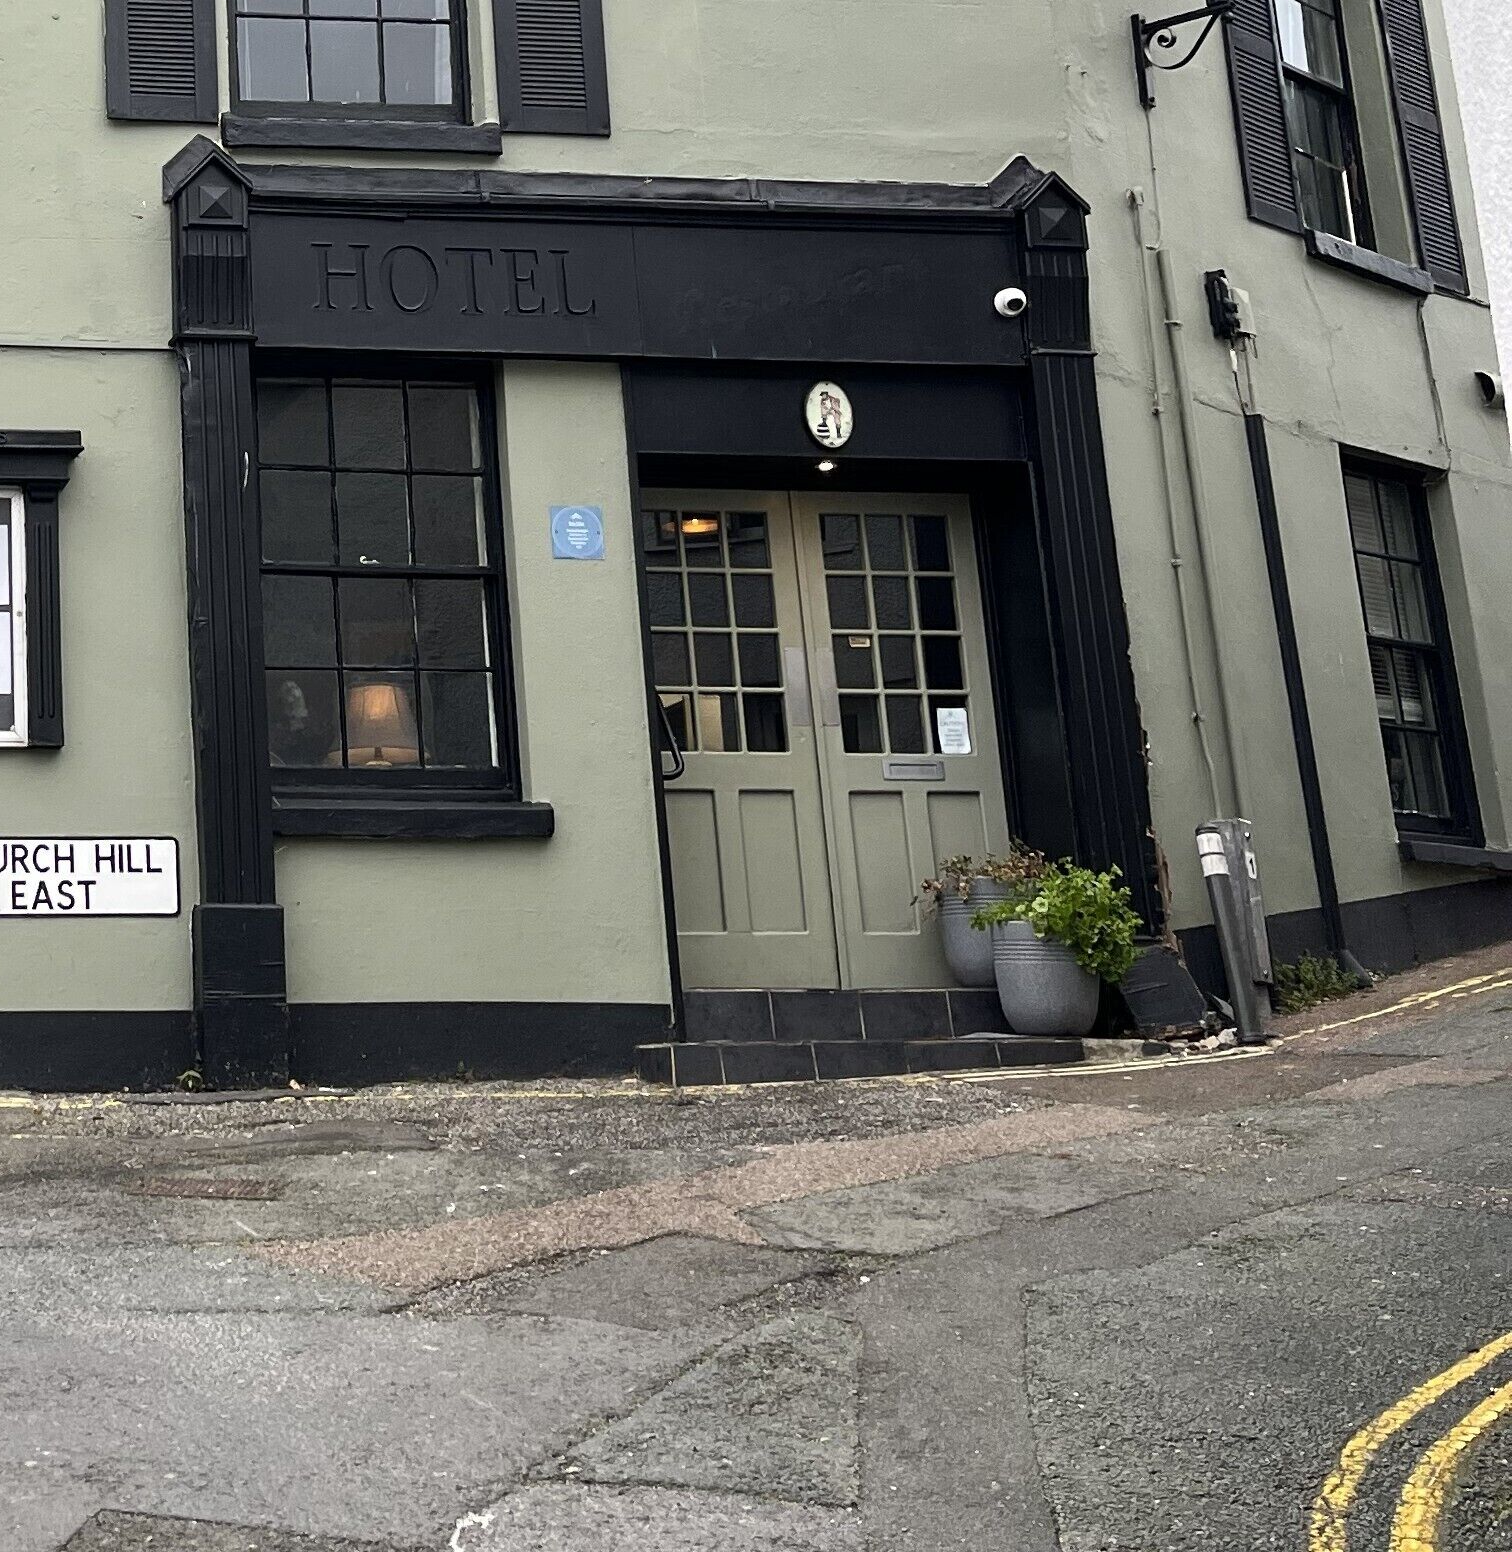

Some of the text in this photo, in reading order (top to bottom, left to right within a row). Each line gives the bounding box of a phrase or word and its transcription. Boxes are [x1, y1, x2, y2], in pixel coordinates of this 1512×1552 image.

[310, 242, 598, 316] HOTEL
[94, 843, 163, 874] HILL
[11, 880, 97, 910] EAST
